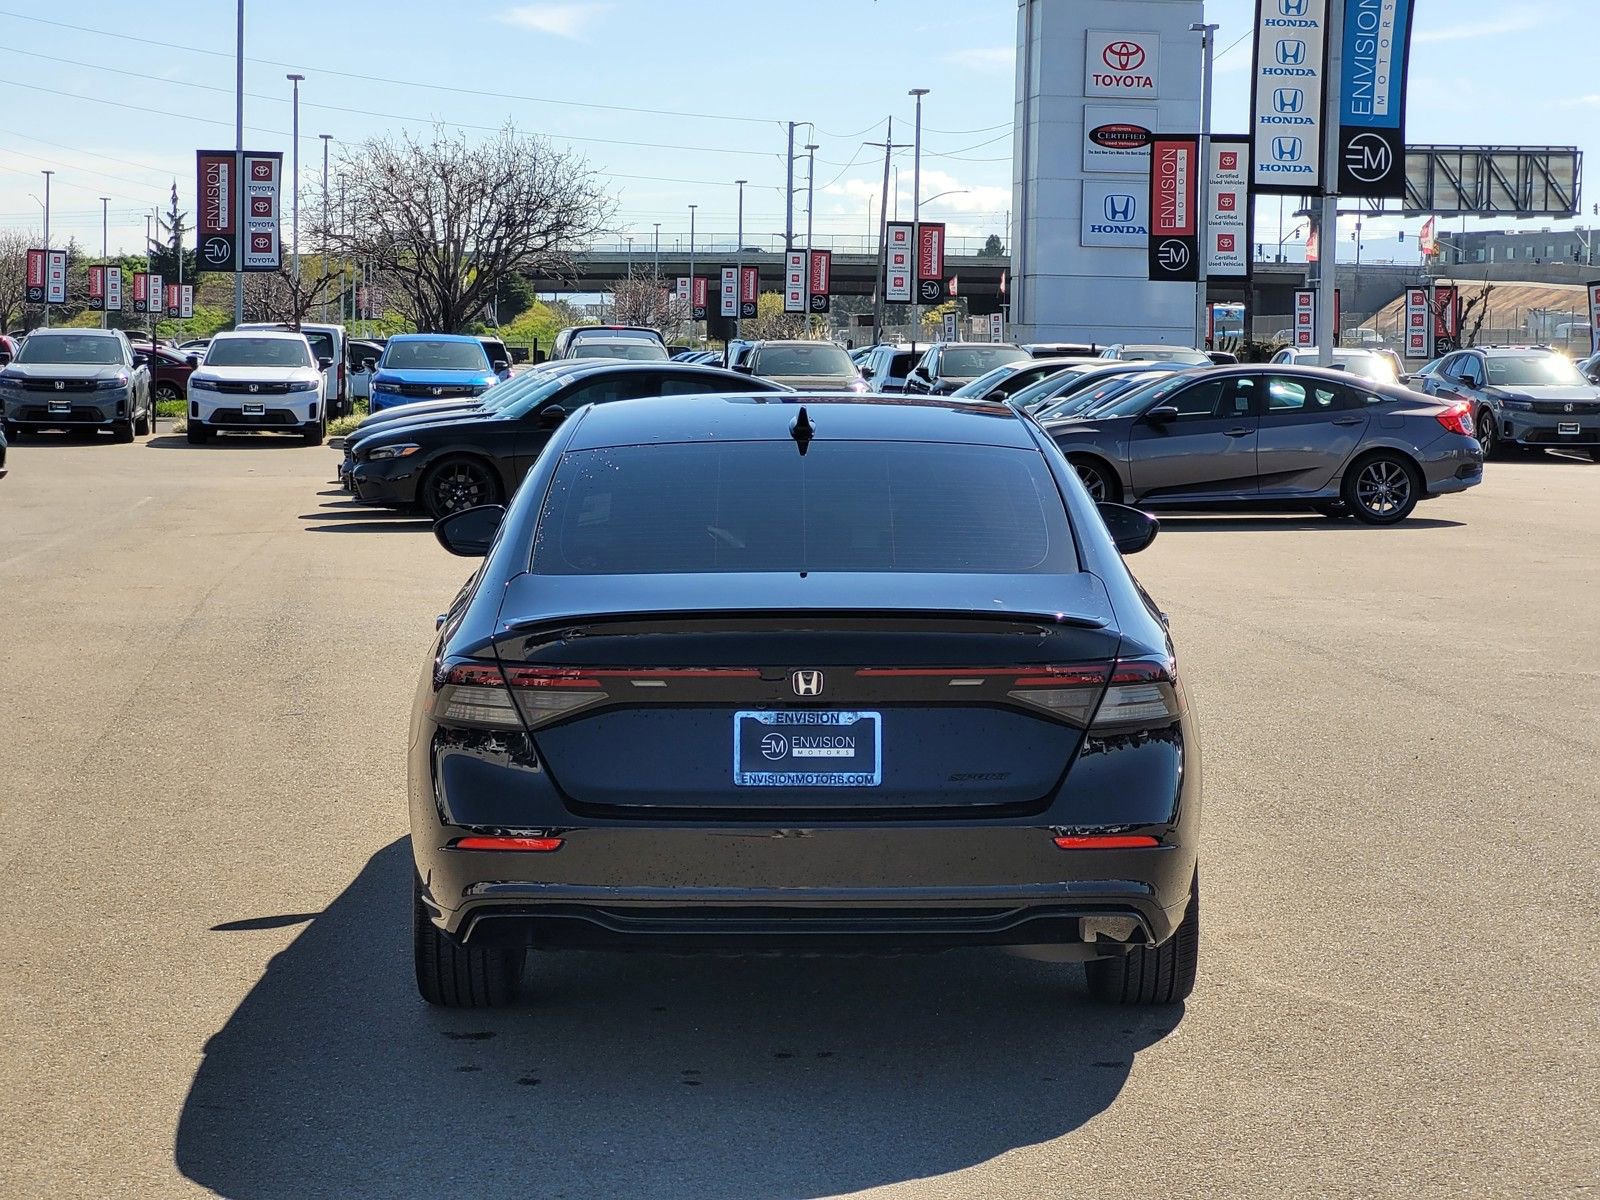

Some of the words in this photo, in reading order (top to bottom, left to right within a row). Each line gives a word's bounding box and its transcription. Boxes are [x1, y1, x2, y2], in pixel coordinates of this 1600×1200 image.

[1264, 18, 1319, 28] HONDA
[1377, 4, 1393, 105] MOTORS
[1262, 67, 1317, 77] HONDA
[1092, 74, 1153, 88] TOYOTA
[1260, 116, 1315, 125] HONDA
[1097, 131, 1146, 140] CERTIFIED
[1259, 164, 1314, 173] HONDA
[1160, 148, 1176, 228] ENVISION
[1178, 156, 1186, 222] MOTORS
[206, 163, 219, 228] ENVISION
[1090, 224, 1148, 234] HONDA
[923, 230, 932, 276] ENVISION
[813, 255, 821, 291] ENVISION
[776, 712, 840, 724] ENVISION
[792, 736, 856, 748] ENVISION
[741, 774, 875, 785] ENVISIONMOTORS.COM
